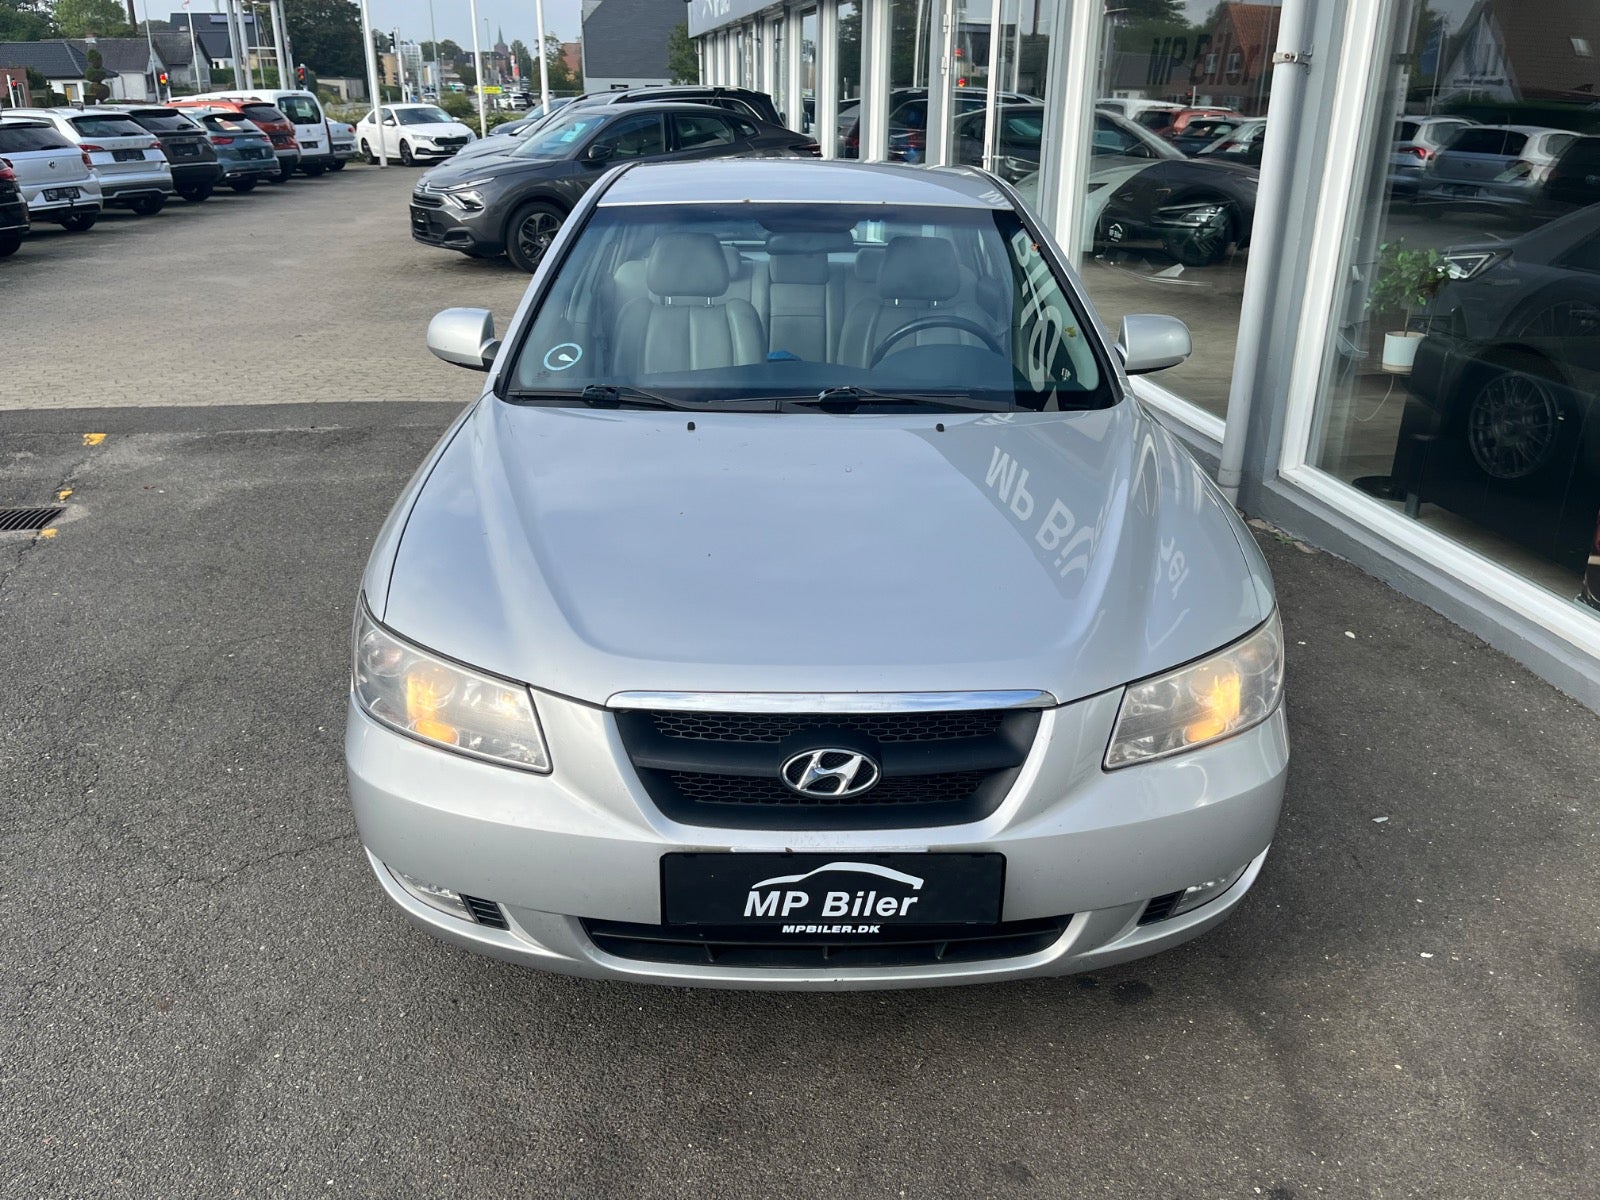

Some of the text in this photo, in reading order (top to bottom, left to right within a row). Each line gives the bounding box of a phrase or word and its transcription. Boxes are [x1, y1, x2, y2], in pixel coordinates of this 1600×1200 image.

[743, 890, 919, 917] MP Biler
[781, 924, 881, 934] MPBILER.DK
